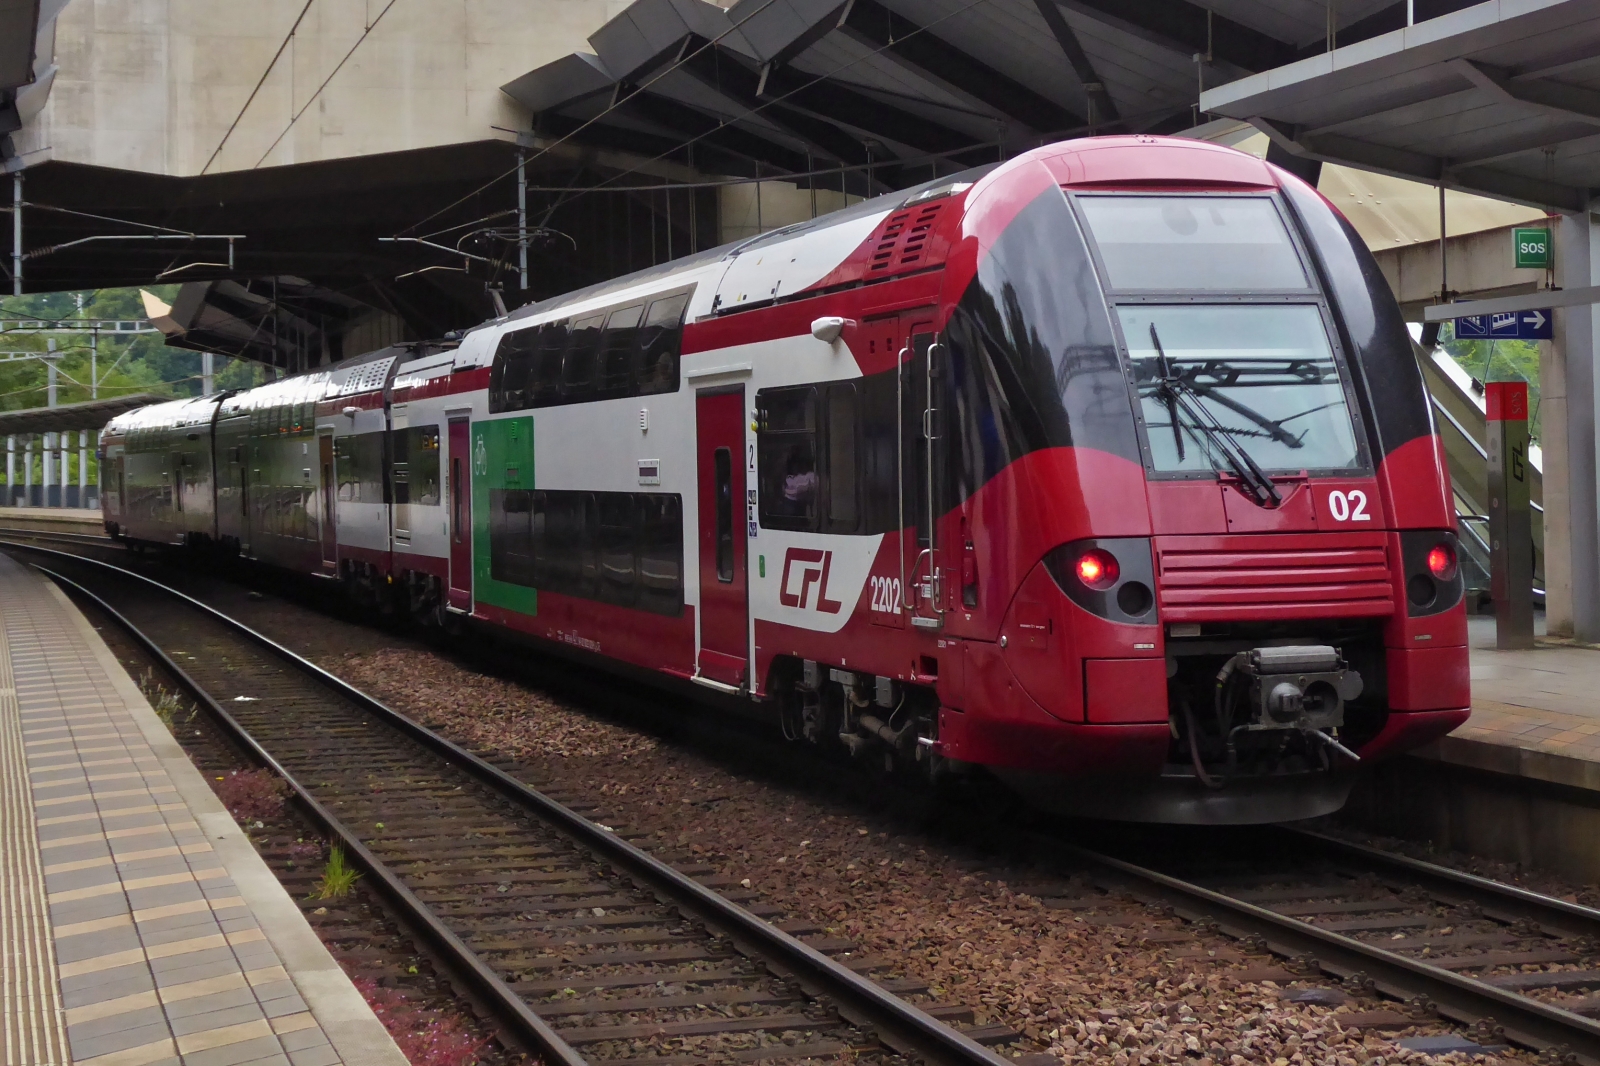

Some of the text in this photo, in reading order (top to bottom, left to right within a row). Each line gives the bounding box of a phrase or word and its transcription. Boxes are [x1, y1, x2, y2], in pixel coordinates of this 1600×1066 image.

[1520, 242, 1546, 254] SOS
[749, 444, 754, 469] 2
[1328, 490, 1371, 522] 02
[780, 547, 842, 615] CFL
[870, 575, 901, 615] 2202
